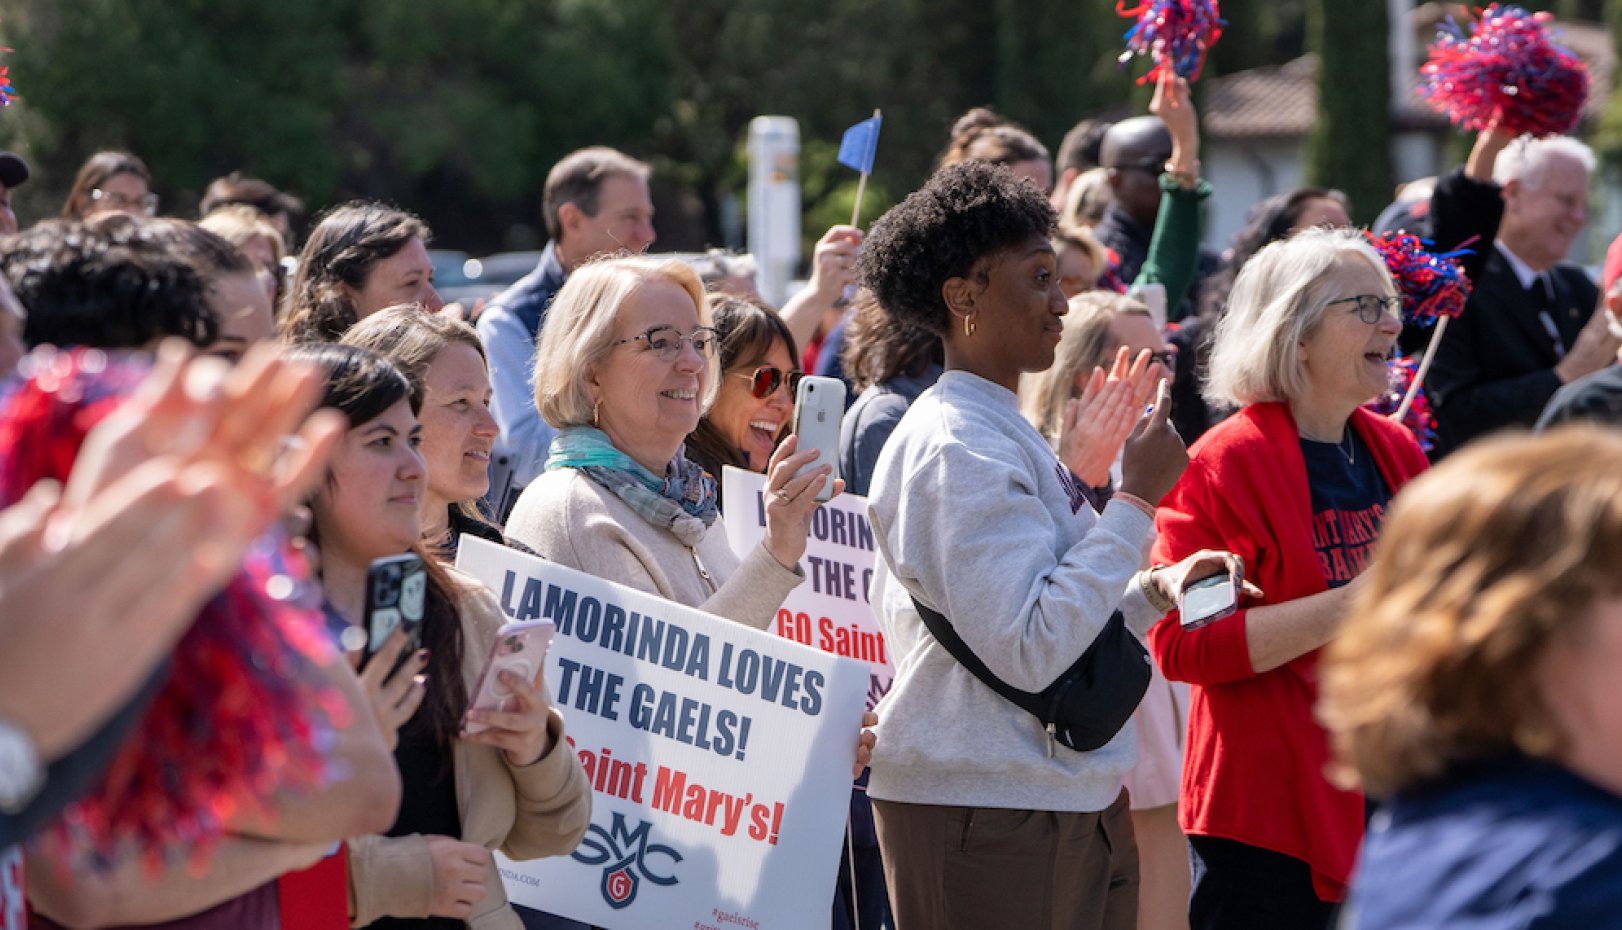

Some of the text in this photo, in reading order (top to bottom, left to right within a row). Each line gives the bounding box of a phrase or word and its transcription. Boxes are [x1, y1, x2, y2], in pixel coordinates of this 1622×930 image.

[807, 555, 857, 601] THE
[501, 570, 710, 682] LAMORINDA
[718, 642, 826, 717] LOVES
[777, 608, 888, 664] GO Saint
[558, 657, 753, 762] THE GAELS!
[565, 735, 785, 846] aint Mary's!
